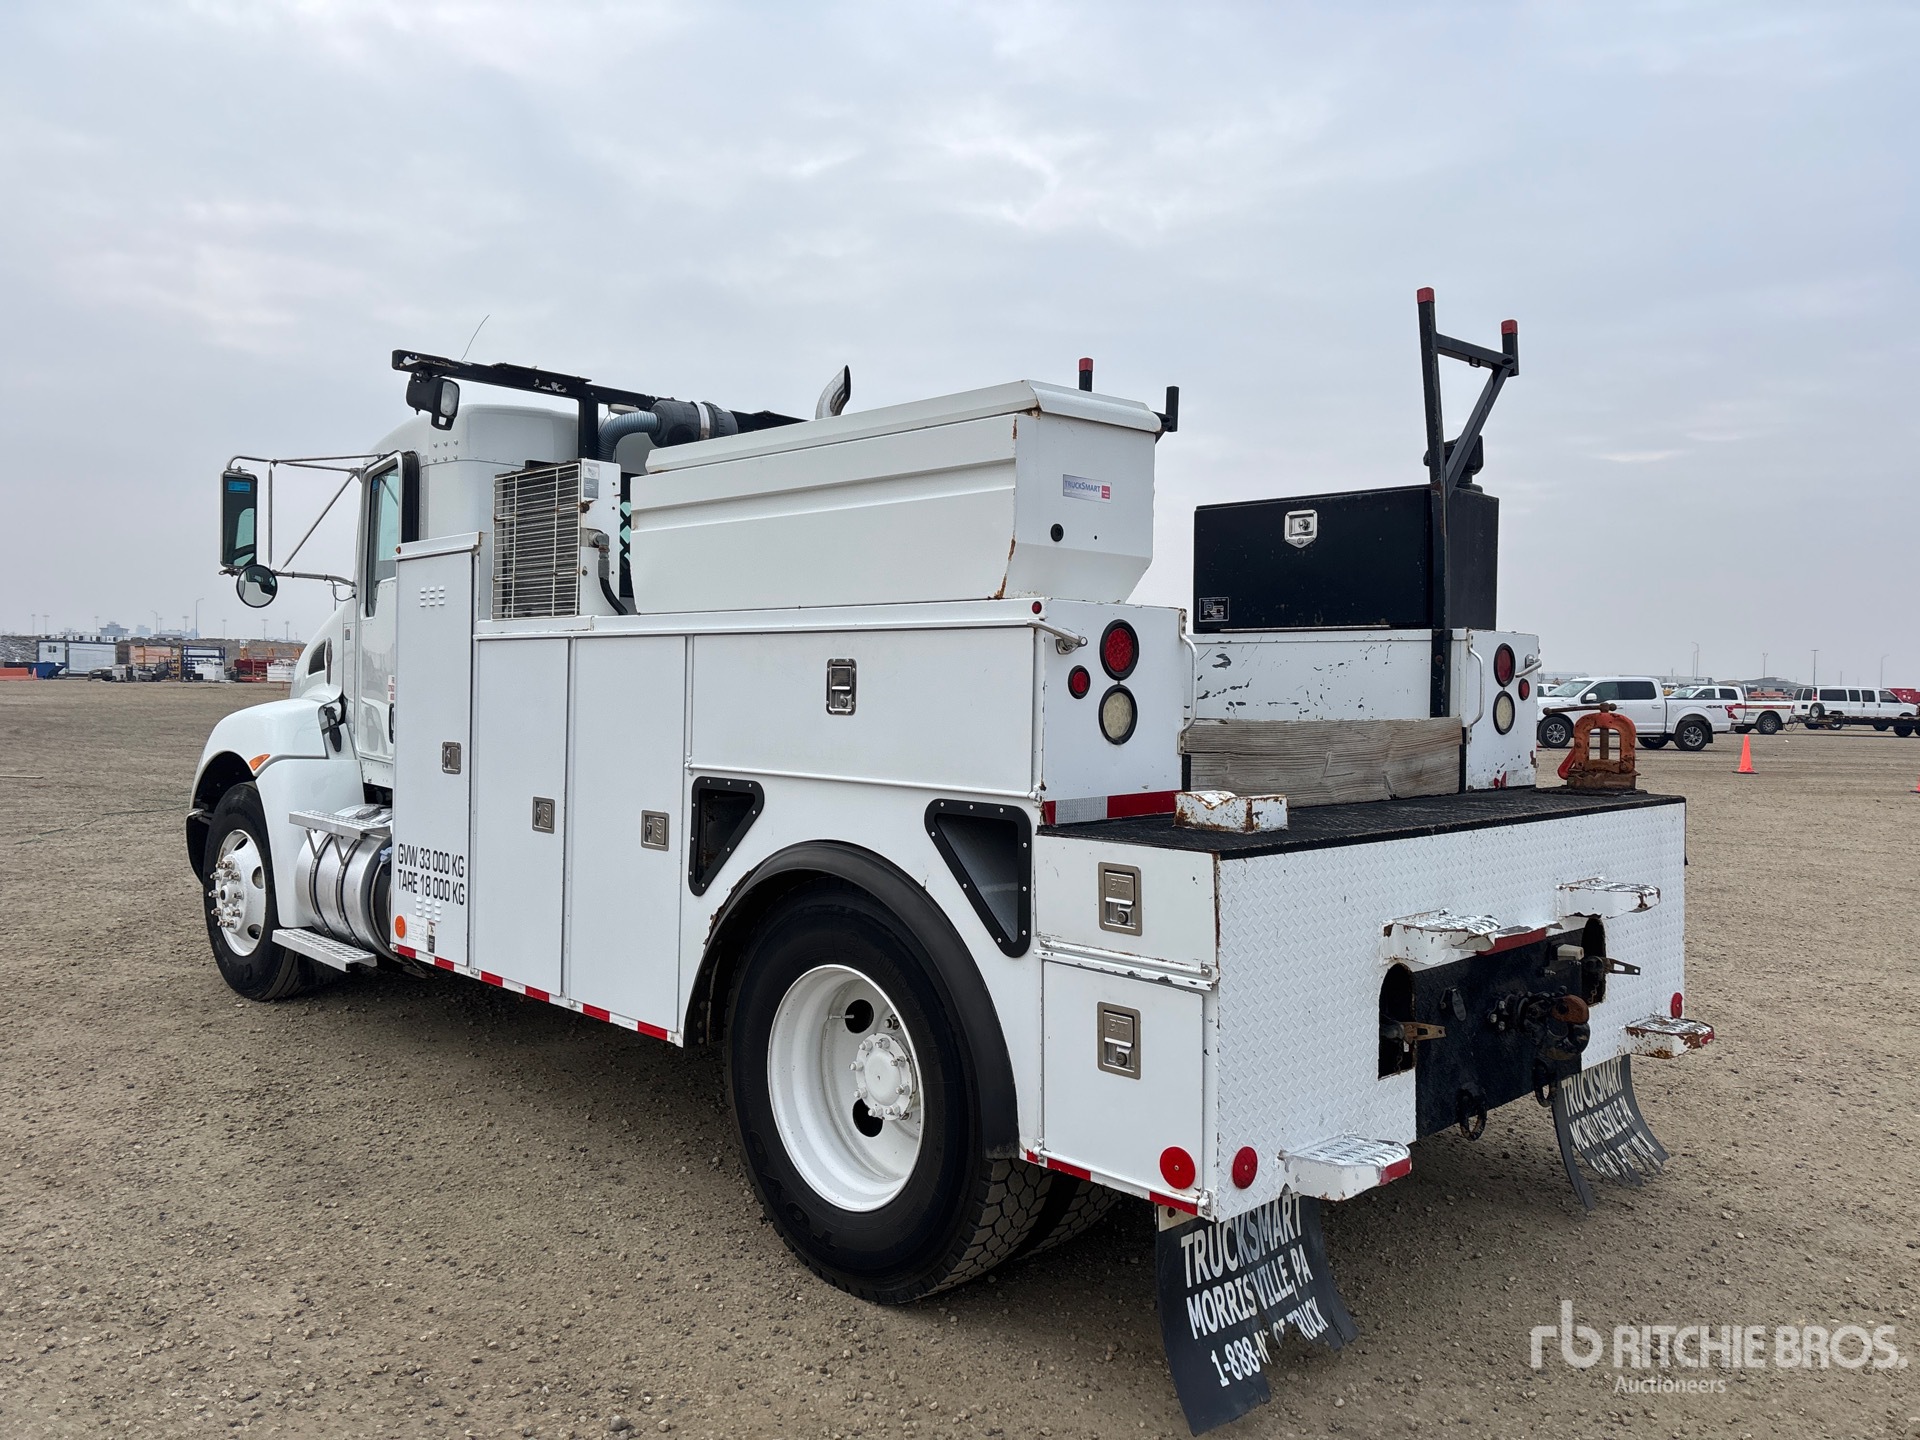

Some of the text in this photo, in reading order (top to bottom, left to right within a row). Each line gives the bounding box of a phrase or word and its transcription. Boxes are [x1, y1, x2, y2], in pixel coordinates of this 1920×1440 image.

[397, 843, 465, 878] GVW 33 000 KG
[397, 868, 465, 905] TARE 18 000 KG
[1561, 1056, 1624, 1118] TRUCKSMART
[1180, 1194, 1303, 1289] TRUCKSMART
[1290, 1243, 1314, 1288] PA
